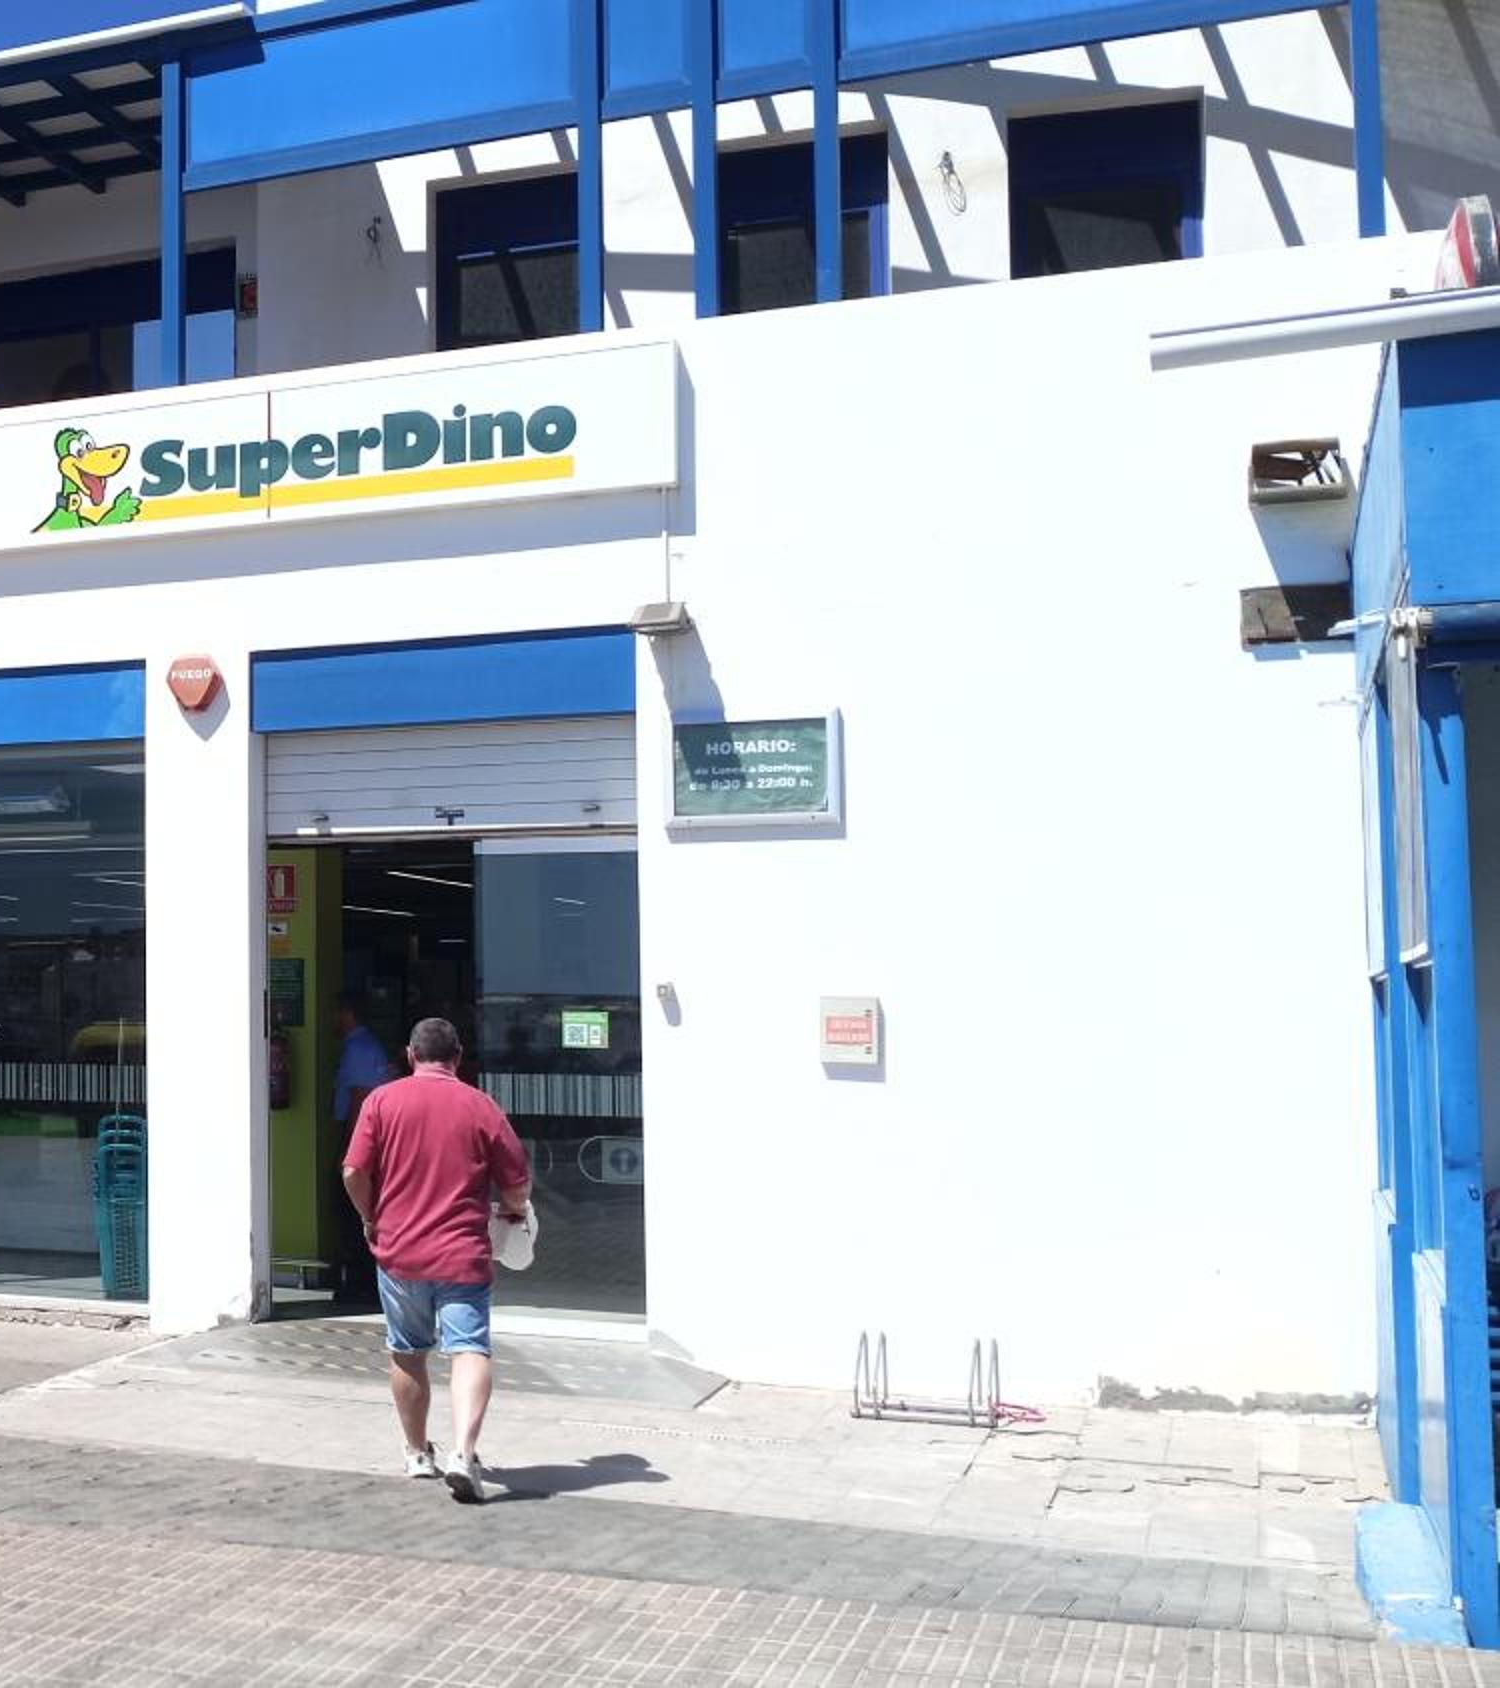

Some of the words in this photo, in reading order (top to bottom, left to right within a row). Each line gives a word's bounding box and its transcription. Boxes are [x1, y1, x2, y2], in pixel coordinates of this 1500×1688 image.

[139, 403, 578, 498] SuperDino
[171, 667, 211, 680] FUEGO
[705, 739, 798, 756] HORARIO:
[754, 776, 795, 789] 22:00
